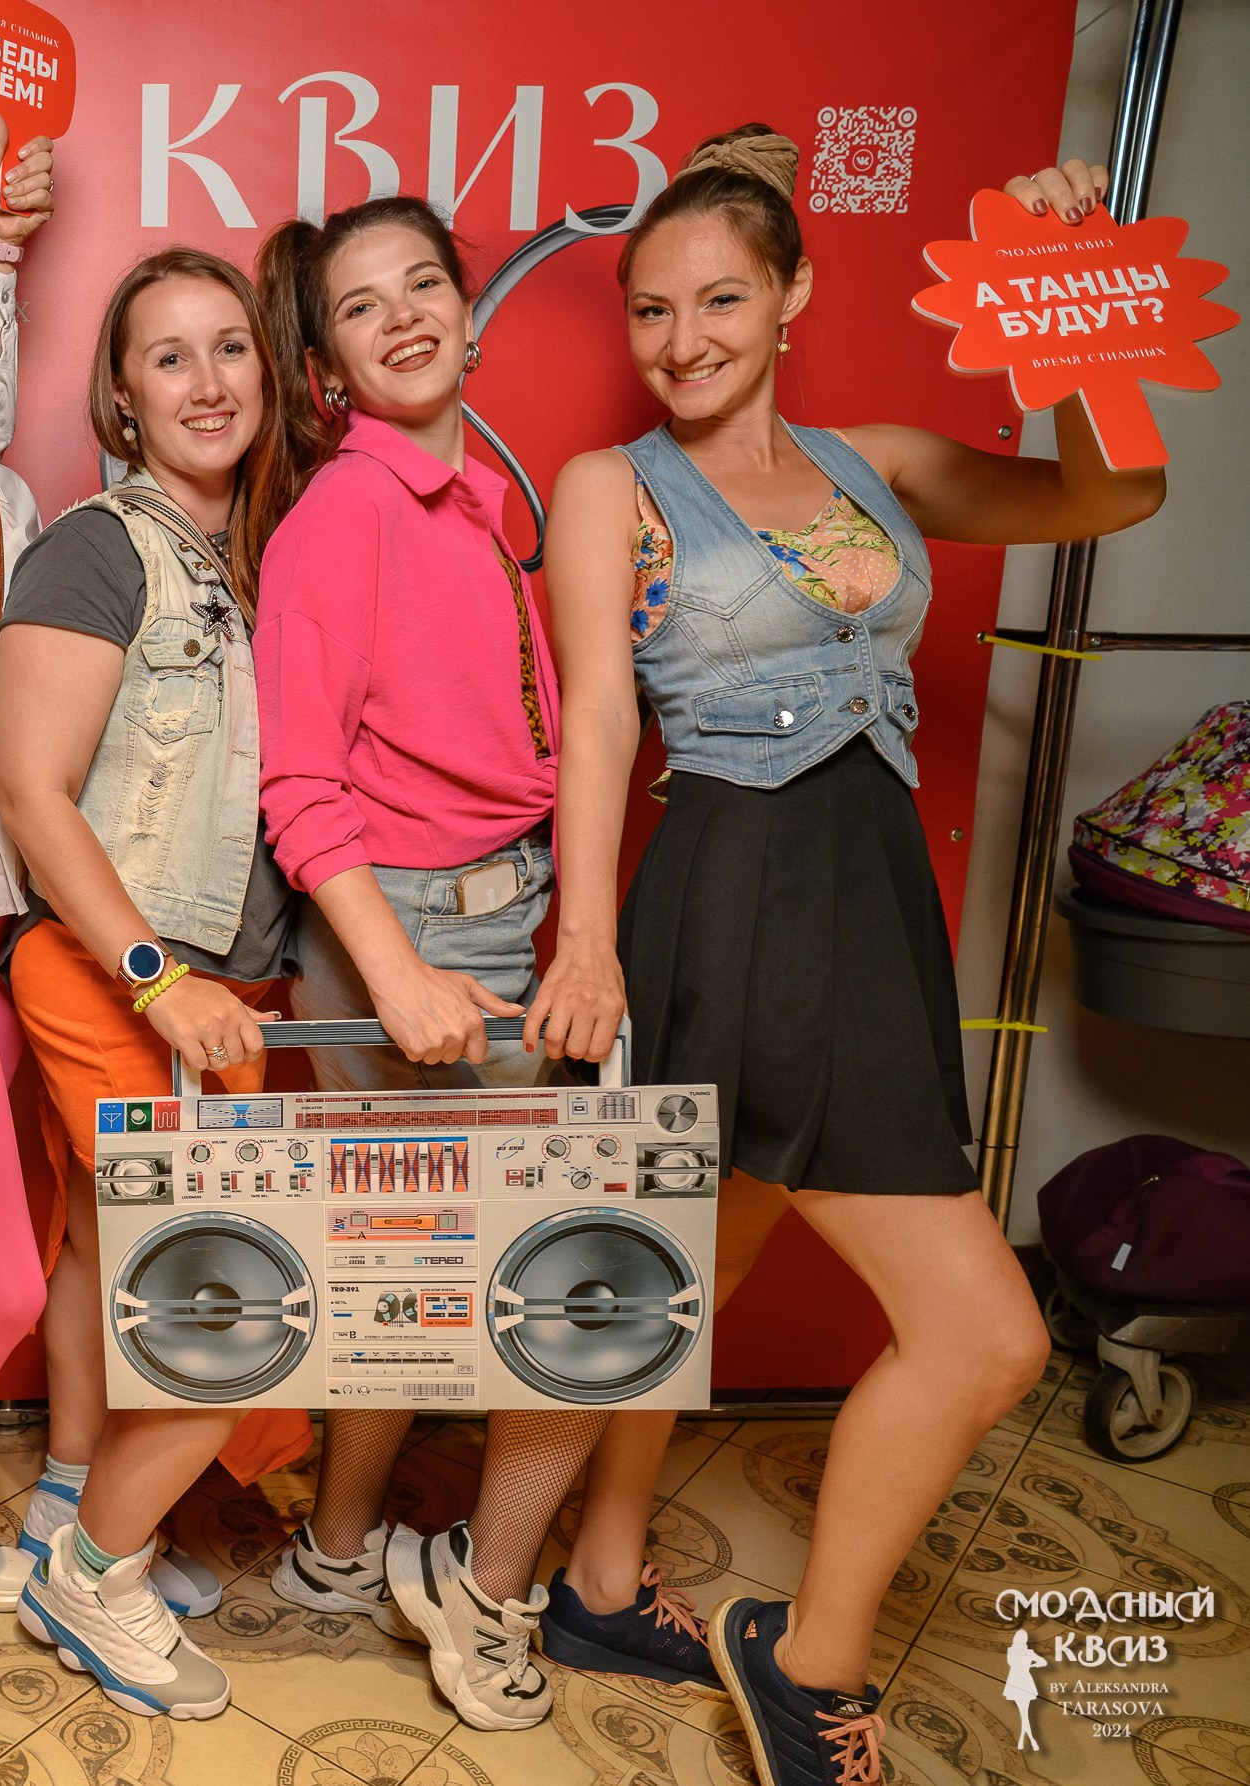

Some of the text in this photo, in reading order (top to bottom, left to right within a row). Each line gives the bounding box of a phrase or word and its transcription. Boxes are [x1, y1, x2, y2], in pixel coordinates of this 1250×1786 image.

[10, 23, 59, 49] СТИЛЬНЫХ
[140, 70, 668, 234] КВИЗ
[995, 237, 1114, 259] МОДНЫЙ КВИЗ
[975, 263, 1171, 308] А ТАНЦЫ
[997, 297, 1165, 338] БУДУТ?
[1031, 346, 1167, 369] ВРЕМЯ СТИЛЬНЫХ
[414, 1256, 464, 1264] STEREO
